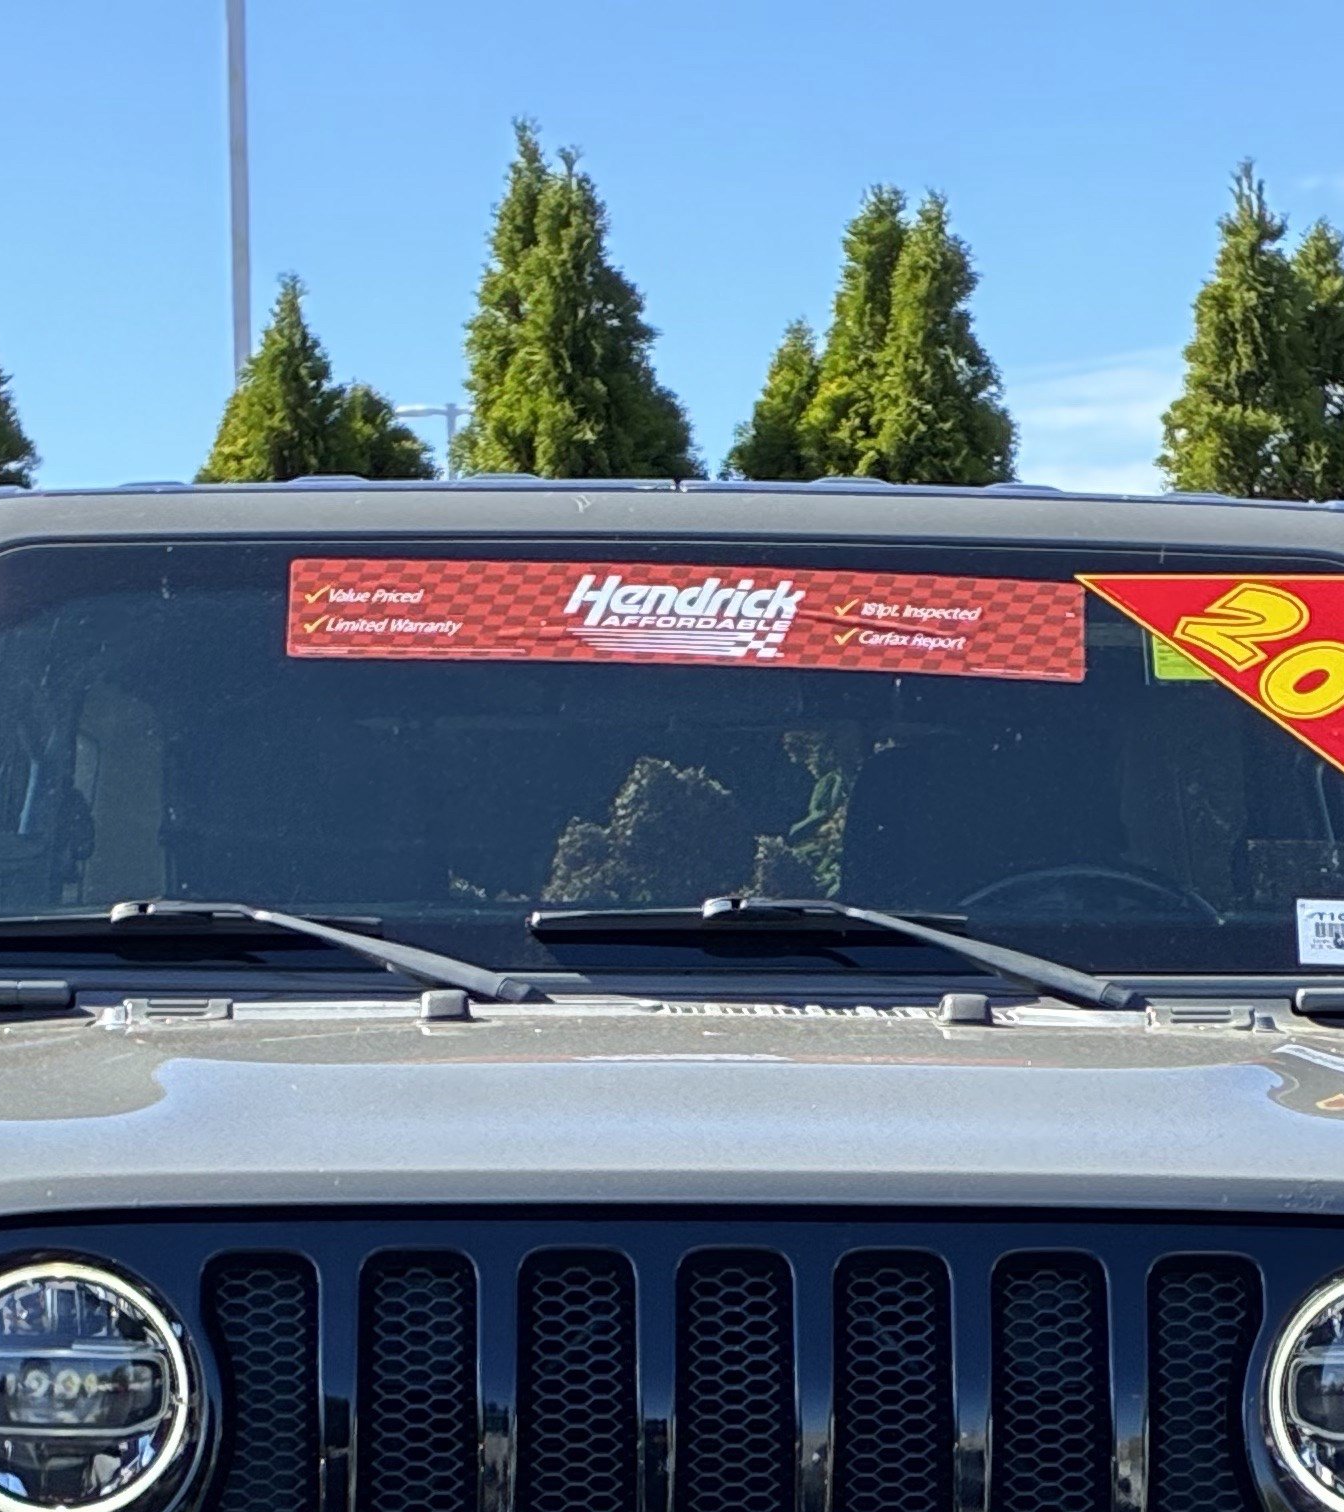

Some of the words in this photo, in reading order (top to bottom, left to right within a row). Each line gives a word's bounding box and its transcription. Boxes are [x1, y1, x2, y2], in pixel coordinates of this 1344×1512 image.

[328, 588, 370, 603] Value
[372, 588, 425, 604] Priced
[563, 574, 806, 626] Hendrick
[903, 604, 983, 622] Inspected
[326, 617, 389, 632] Limited
[390, 618, 464, 637] Warranty
[601, 615, 792, 631] AFFORDABLE
[859, 630, 910, 646] Carfax
[911, 633, 967, 650] Report
